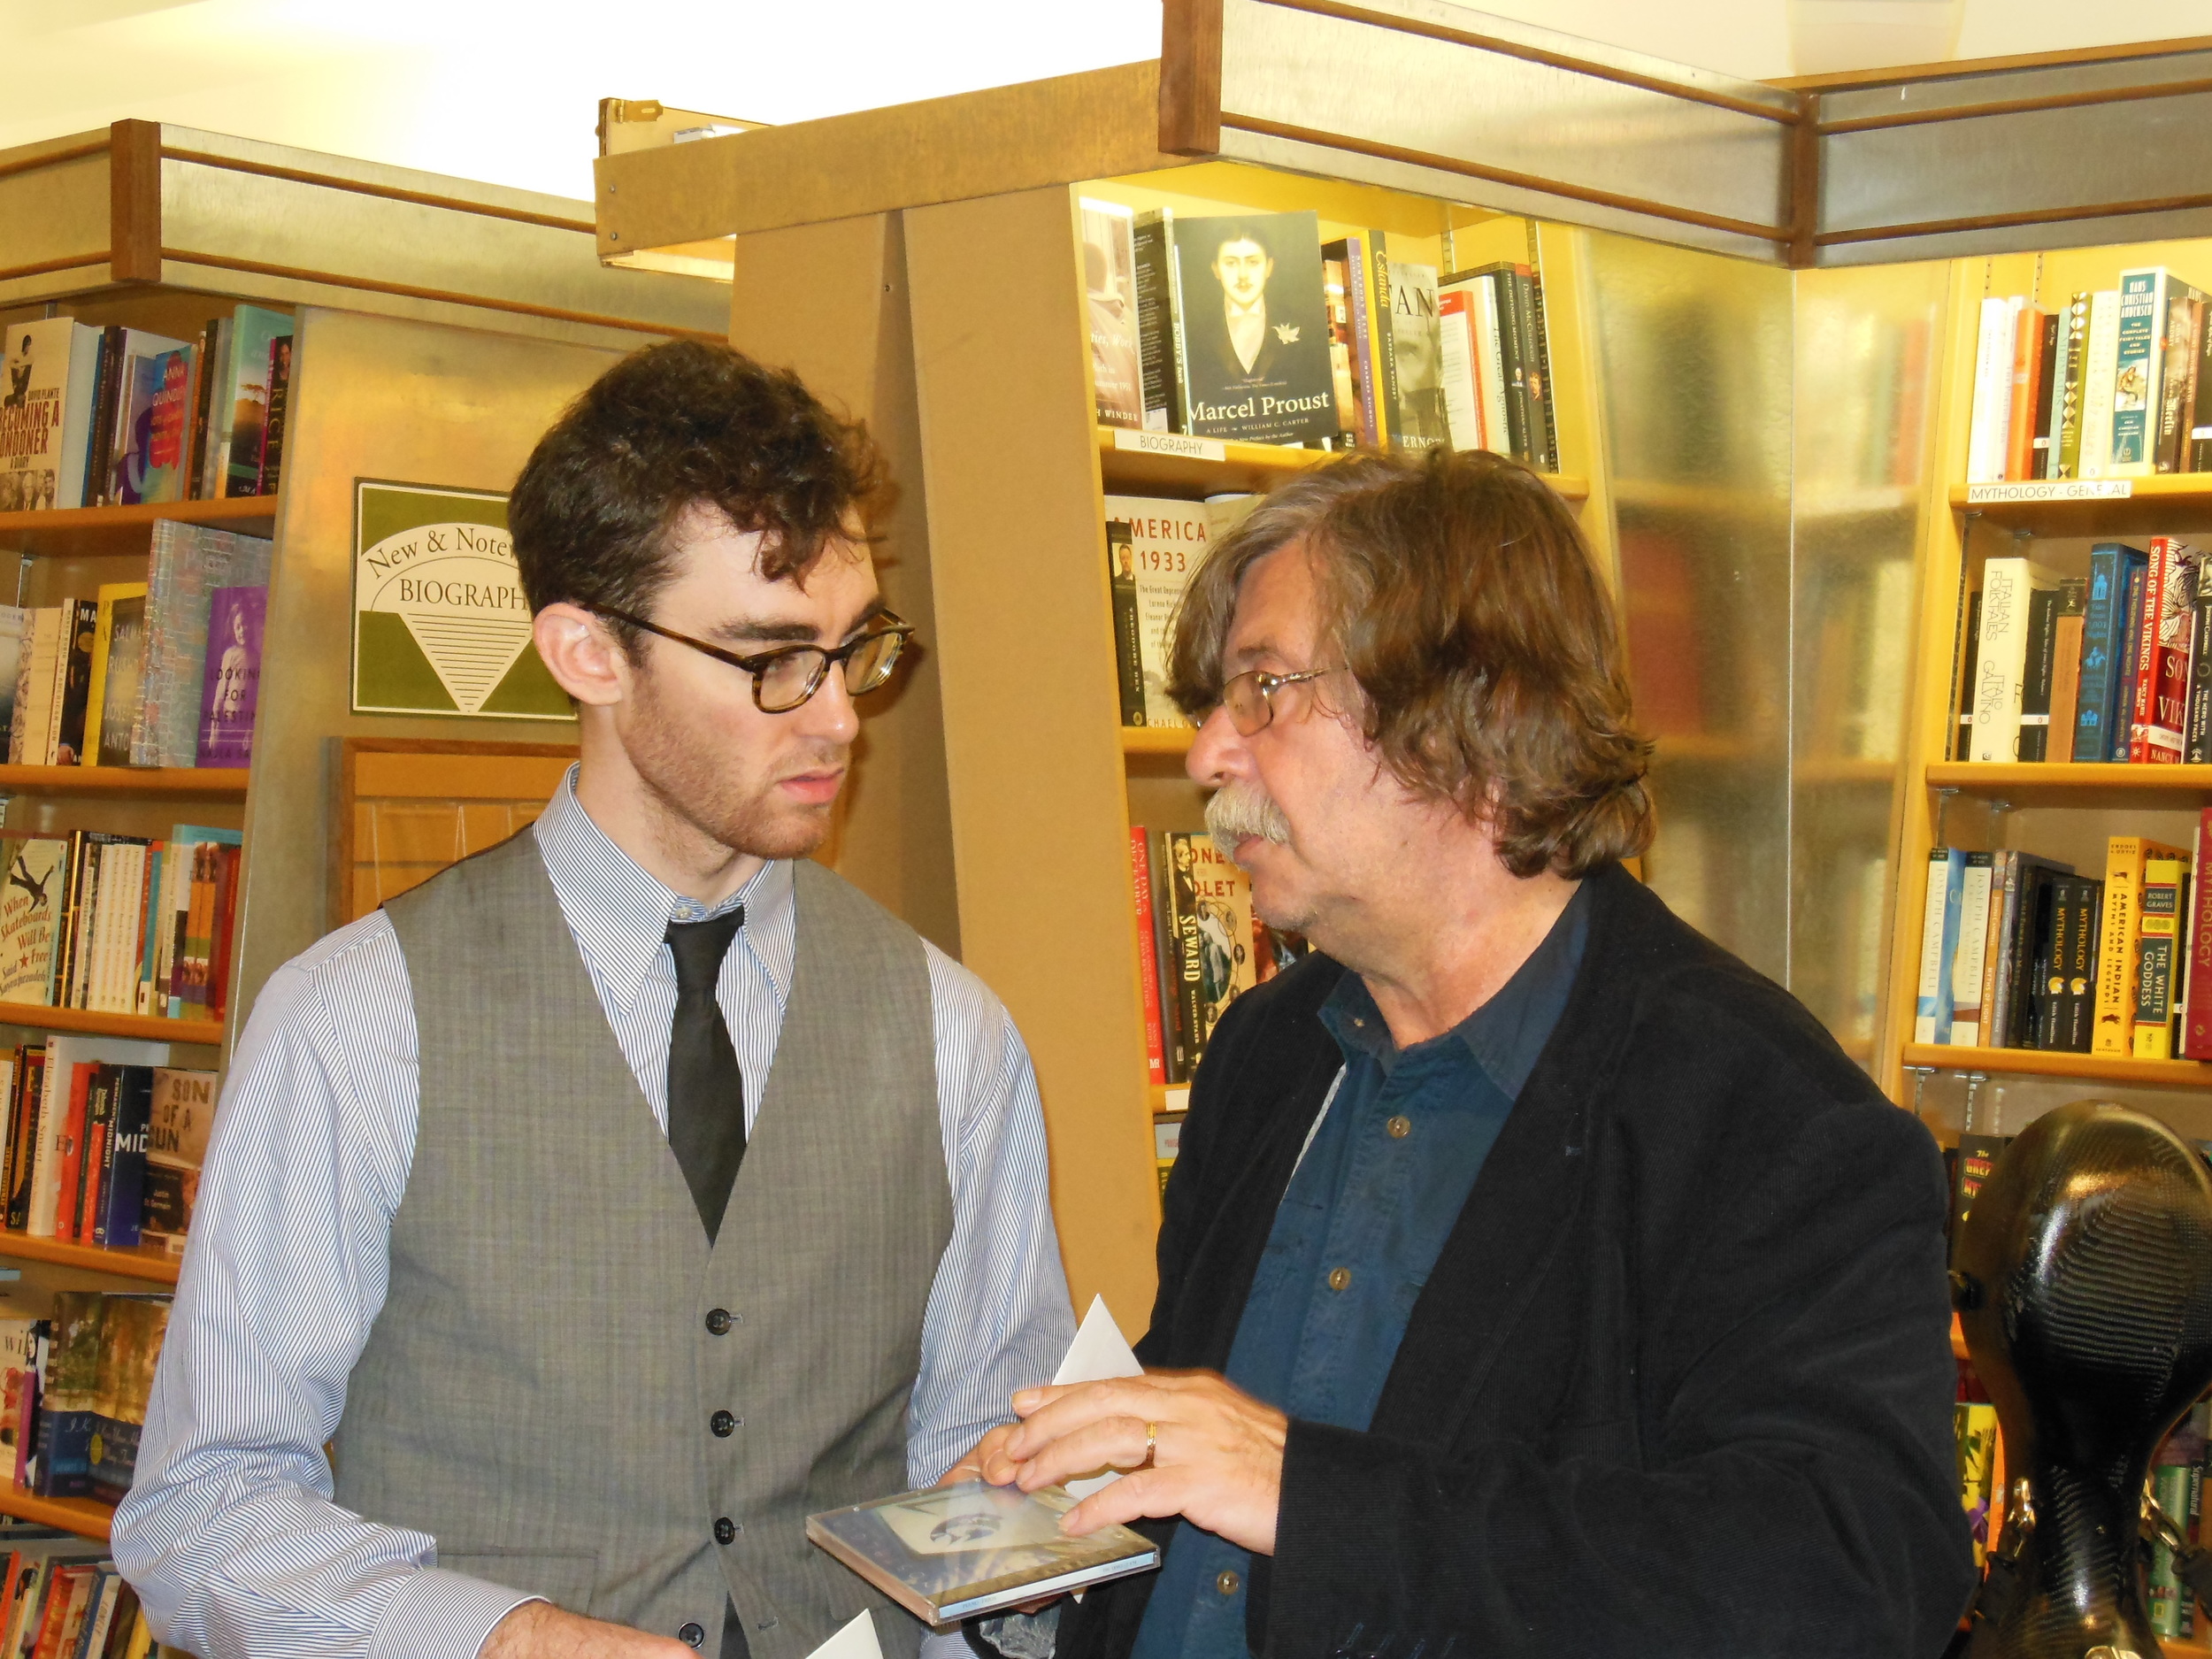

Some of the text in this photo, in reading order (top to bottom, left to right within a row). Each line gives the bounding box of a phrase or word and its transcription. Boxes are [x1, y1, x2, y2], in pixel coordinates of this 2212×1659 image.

[1375, 250, 1391, 308] Eslanda
[2121, 292, 2154, 306] CHRISTIAN
[2129, 281, 2146, 293] HANS
[1508, 289, 1517, 326] DEFINING
[2121, 303, 2153, 319] ANDERSEN
[1173, 322, 1183, 365] BOBBY'S
[51, 400, 59, 426] A
[268, 388, 283, 449] RICE
[1190, 392, 1330, 421] Marcel Proust
[1241, 423, 1272, 432] WILLIAM
[1283, 418, 1310, 426] CARTER
[1517, 391, 1526, 426] JONATHAN
[1140, 434, 1203, 455] BIOGRAPHY
[1970, 480, 2127, 502] MYTHOLOGY GENEAL
[365, 541, 419, 580] New
[427, 530, 448, 553] &
[1140, 550, 1187, 572] 1933
[1985, 571, 2002, 641] FOLKTALES
[1997, 578, 2013, 634] ITALIAN
[2139, 546, 2161, 671] SONG OF THE VIKINGS
[54, 677, 64, 722] AMERICAN
[223, 689, 247, 702] FOR
[1978, 660, 1995, 725] CALVINO
[1991, 674, 2005, 710] ITALO
[4, 895, 28, 918] When
[1934, 868, 1946, 916] JOSEPH
[1973, 873, 1985, 921] JOSEPH
[2198, 862, 2212, 967] MYTHOLOGY
[0, 905, 51, 942] Skateboards
[18, 926, 50, 951] Will Be
[2053, 907, 2067, 972] MYTHOLOGY
[2075, 908, 2089, 972] MYTHOLOGY
[31, 949, 50, 964] Free
[1179, 914, 1202, 982] SEWARD
[1927, 922, 1940, 991] CAMPBELL
[1968, 927, 1981, 997] CAMPBELL
[2112, 893, 2128, 1003] AMERICAN INDIAN
[1985, 993, 1992, 1002] OF
[2104, 958, 2113, 1004] LEGENDS
[2140, 951, 2154, 1007] GODDESS
[2153, 946, 2168, 1014] THE WHITE
[36, 1056, 55, 1163] Elizabeth Smart
[172, 1079, 211, 1104] SON
[104, 1077, 120, 1169] PERMANENT MIDNIGHT
[163, 1104, 192, 1132] OF A
[2189, 1464, 2203, 1516] Supernatural
